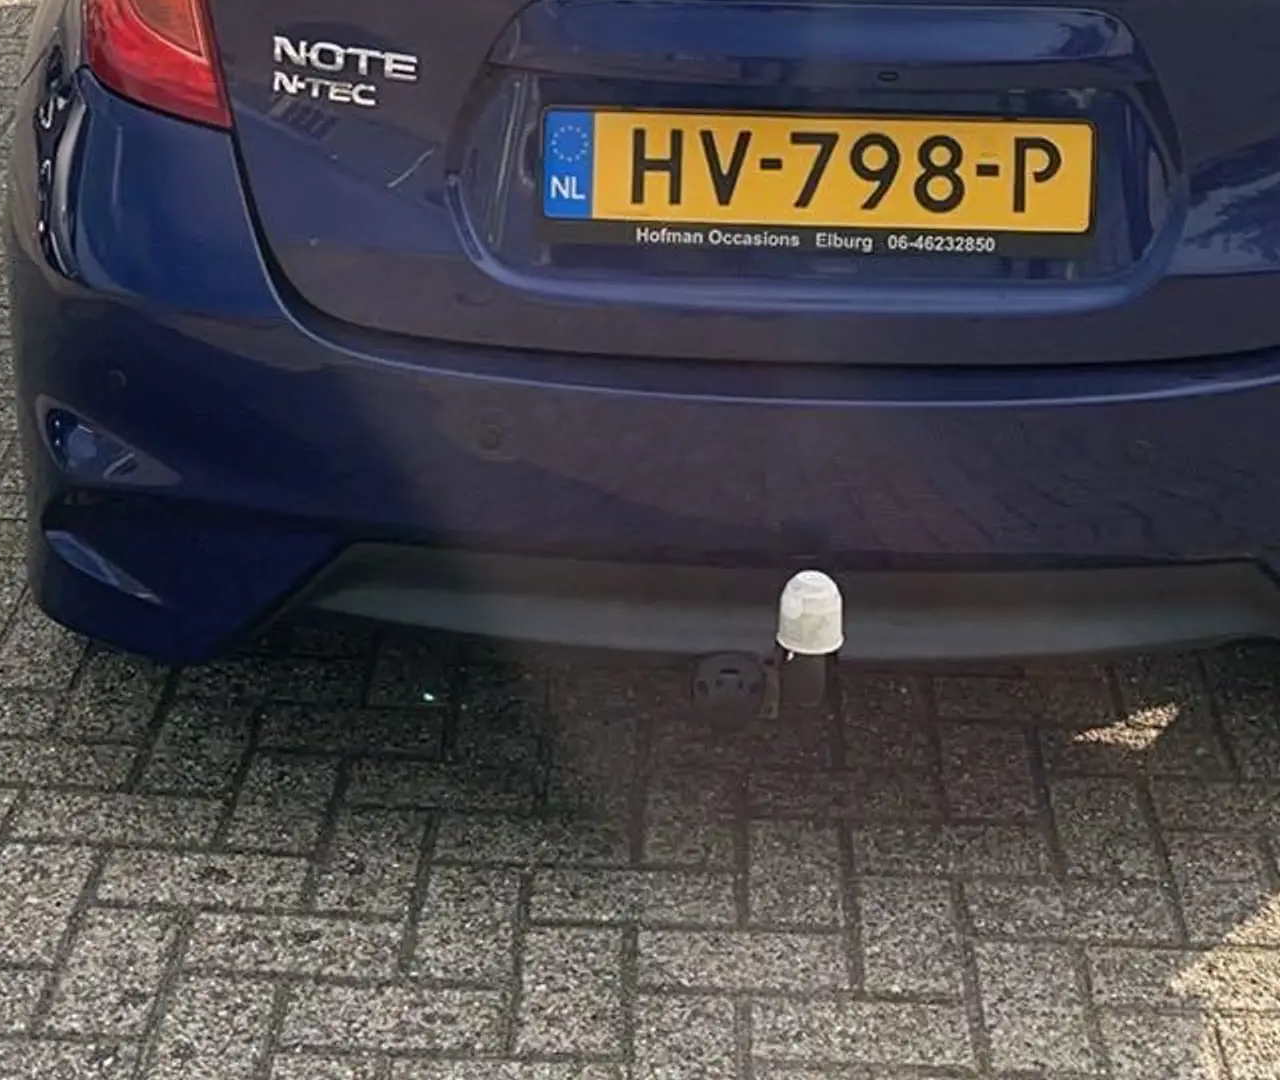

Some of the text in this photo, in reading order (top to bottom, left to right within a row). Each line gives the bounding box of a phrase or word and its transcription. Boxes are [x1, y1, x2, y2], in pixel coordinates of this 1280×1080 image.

[273, 35, 418, 81] NOTE
[273, 71, 377, 107] N-TEC
[549, 175, 586, 201] NL
[630, 127, 1062, 214] HV-798-P
[636, 227, 996, 253] Hofman Occasions Elburg 06-46232850
